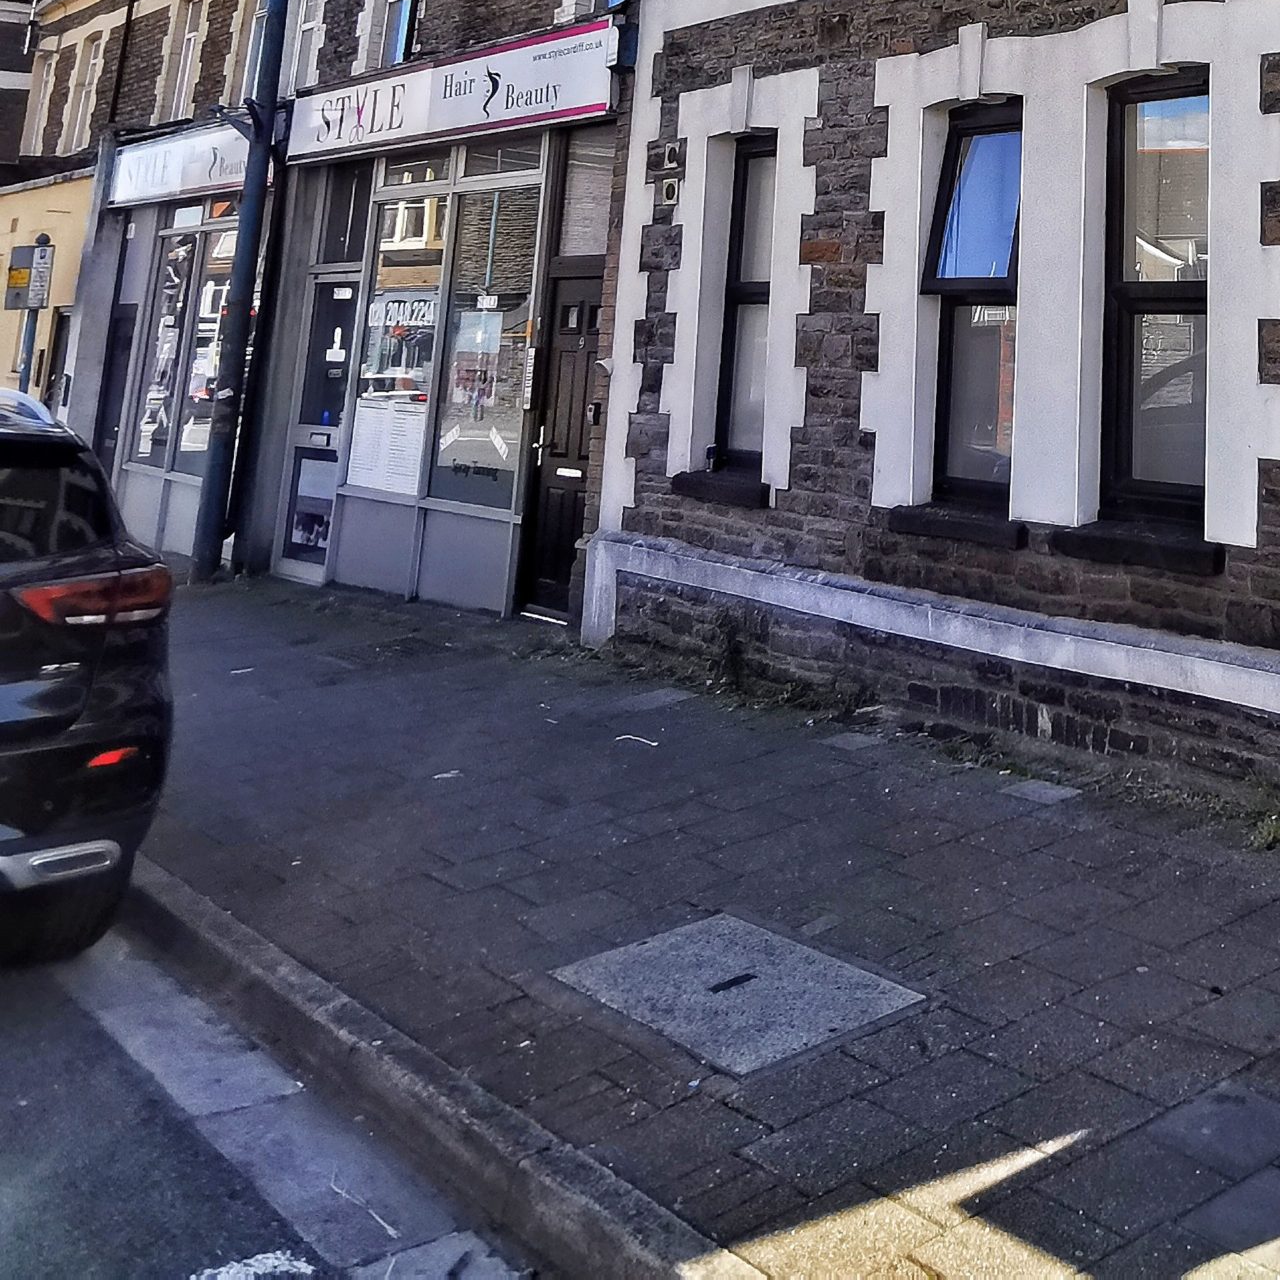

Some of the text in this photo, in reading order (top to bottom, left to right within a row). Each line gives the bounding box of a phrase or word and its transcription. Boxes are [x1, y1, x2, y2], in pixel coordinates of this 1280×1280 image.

[532, 39, 603, 61] www.stylecardiff.co.uk
[442, 70, 476, 99] Hair
[505, 83, 562, 111] Beauty
[317, 83, 406, 144] STYLE
[578, 336, 585, 349] 9
